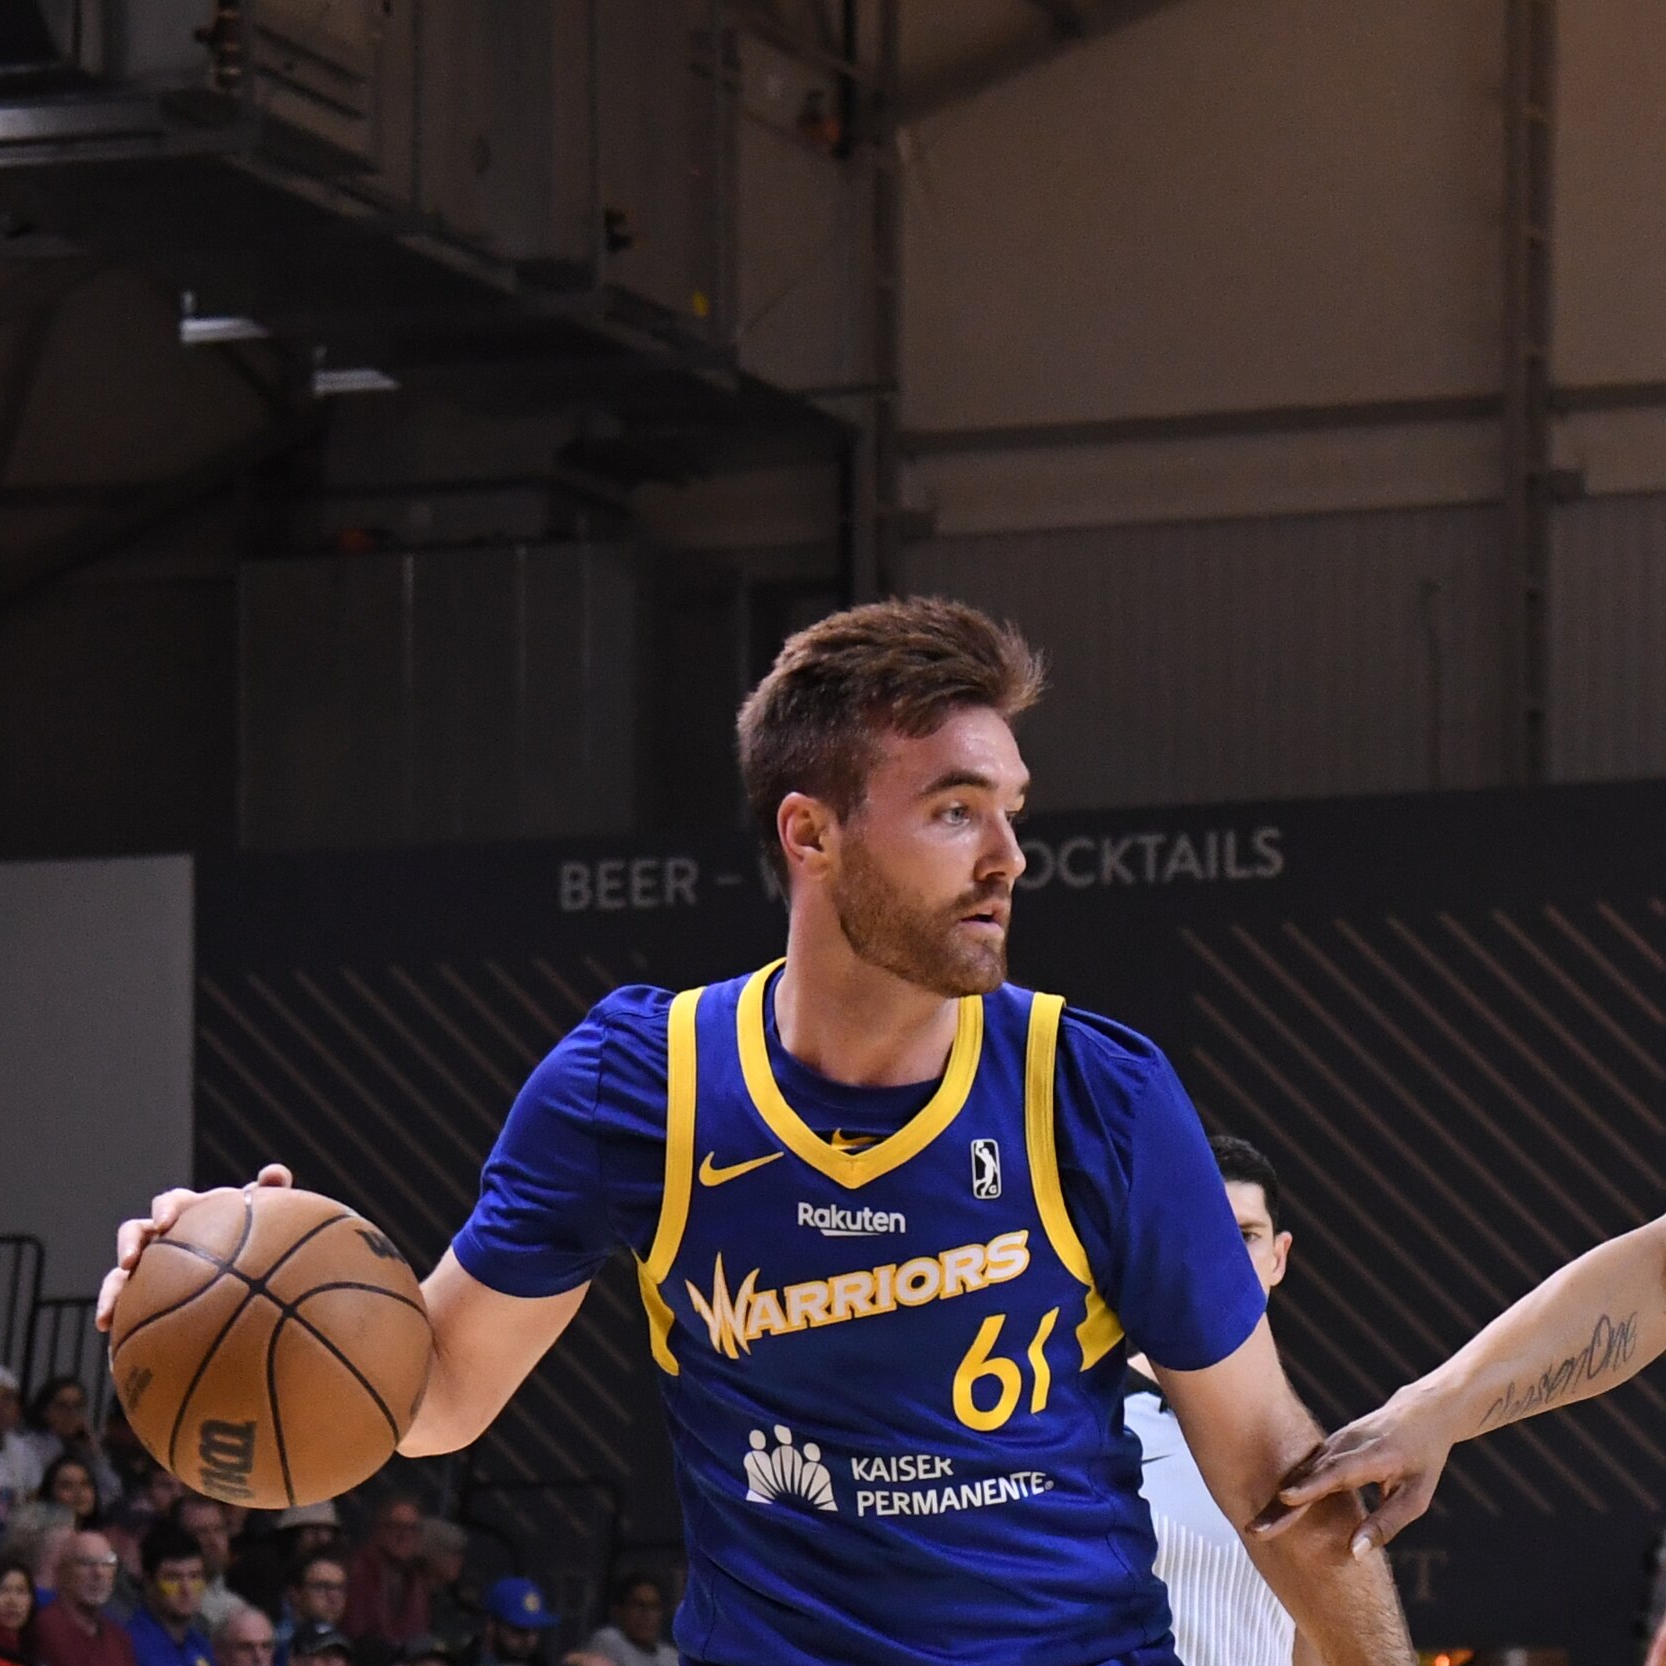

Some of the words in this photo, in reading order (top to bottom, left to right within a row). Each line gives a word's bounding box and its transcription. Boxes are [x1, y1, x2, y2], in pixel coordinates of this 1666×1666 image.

[559, 858, 700, 912] BEER
[1018, 826, 1284, 890] OCKTAILS
[797, 1202, 906, 1236] Rakuten
[685, 1229, 1031, 1359] WARRIORS
[952, 1306, 1059, 1432] 61
[850, 1454, 954, 1483] KAISER
